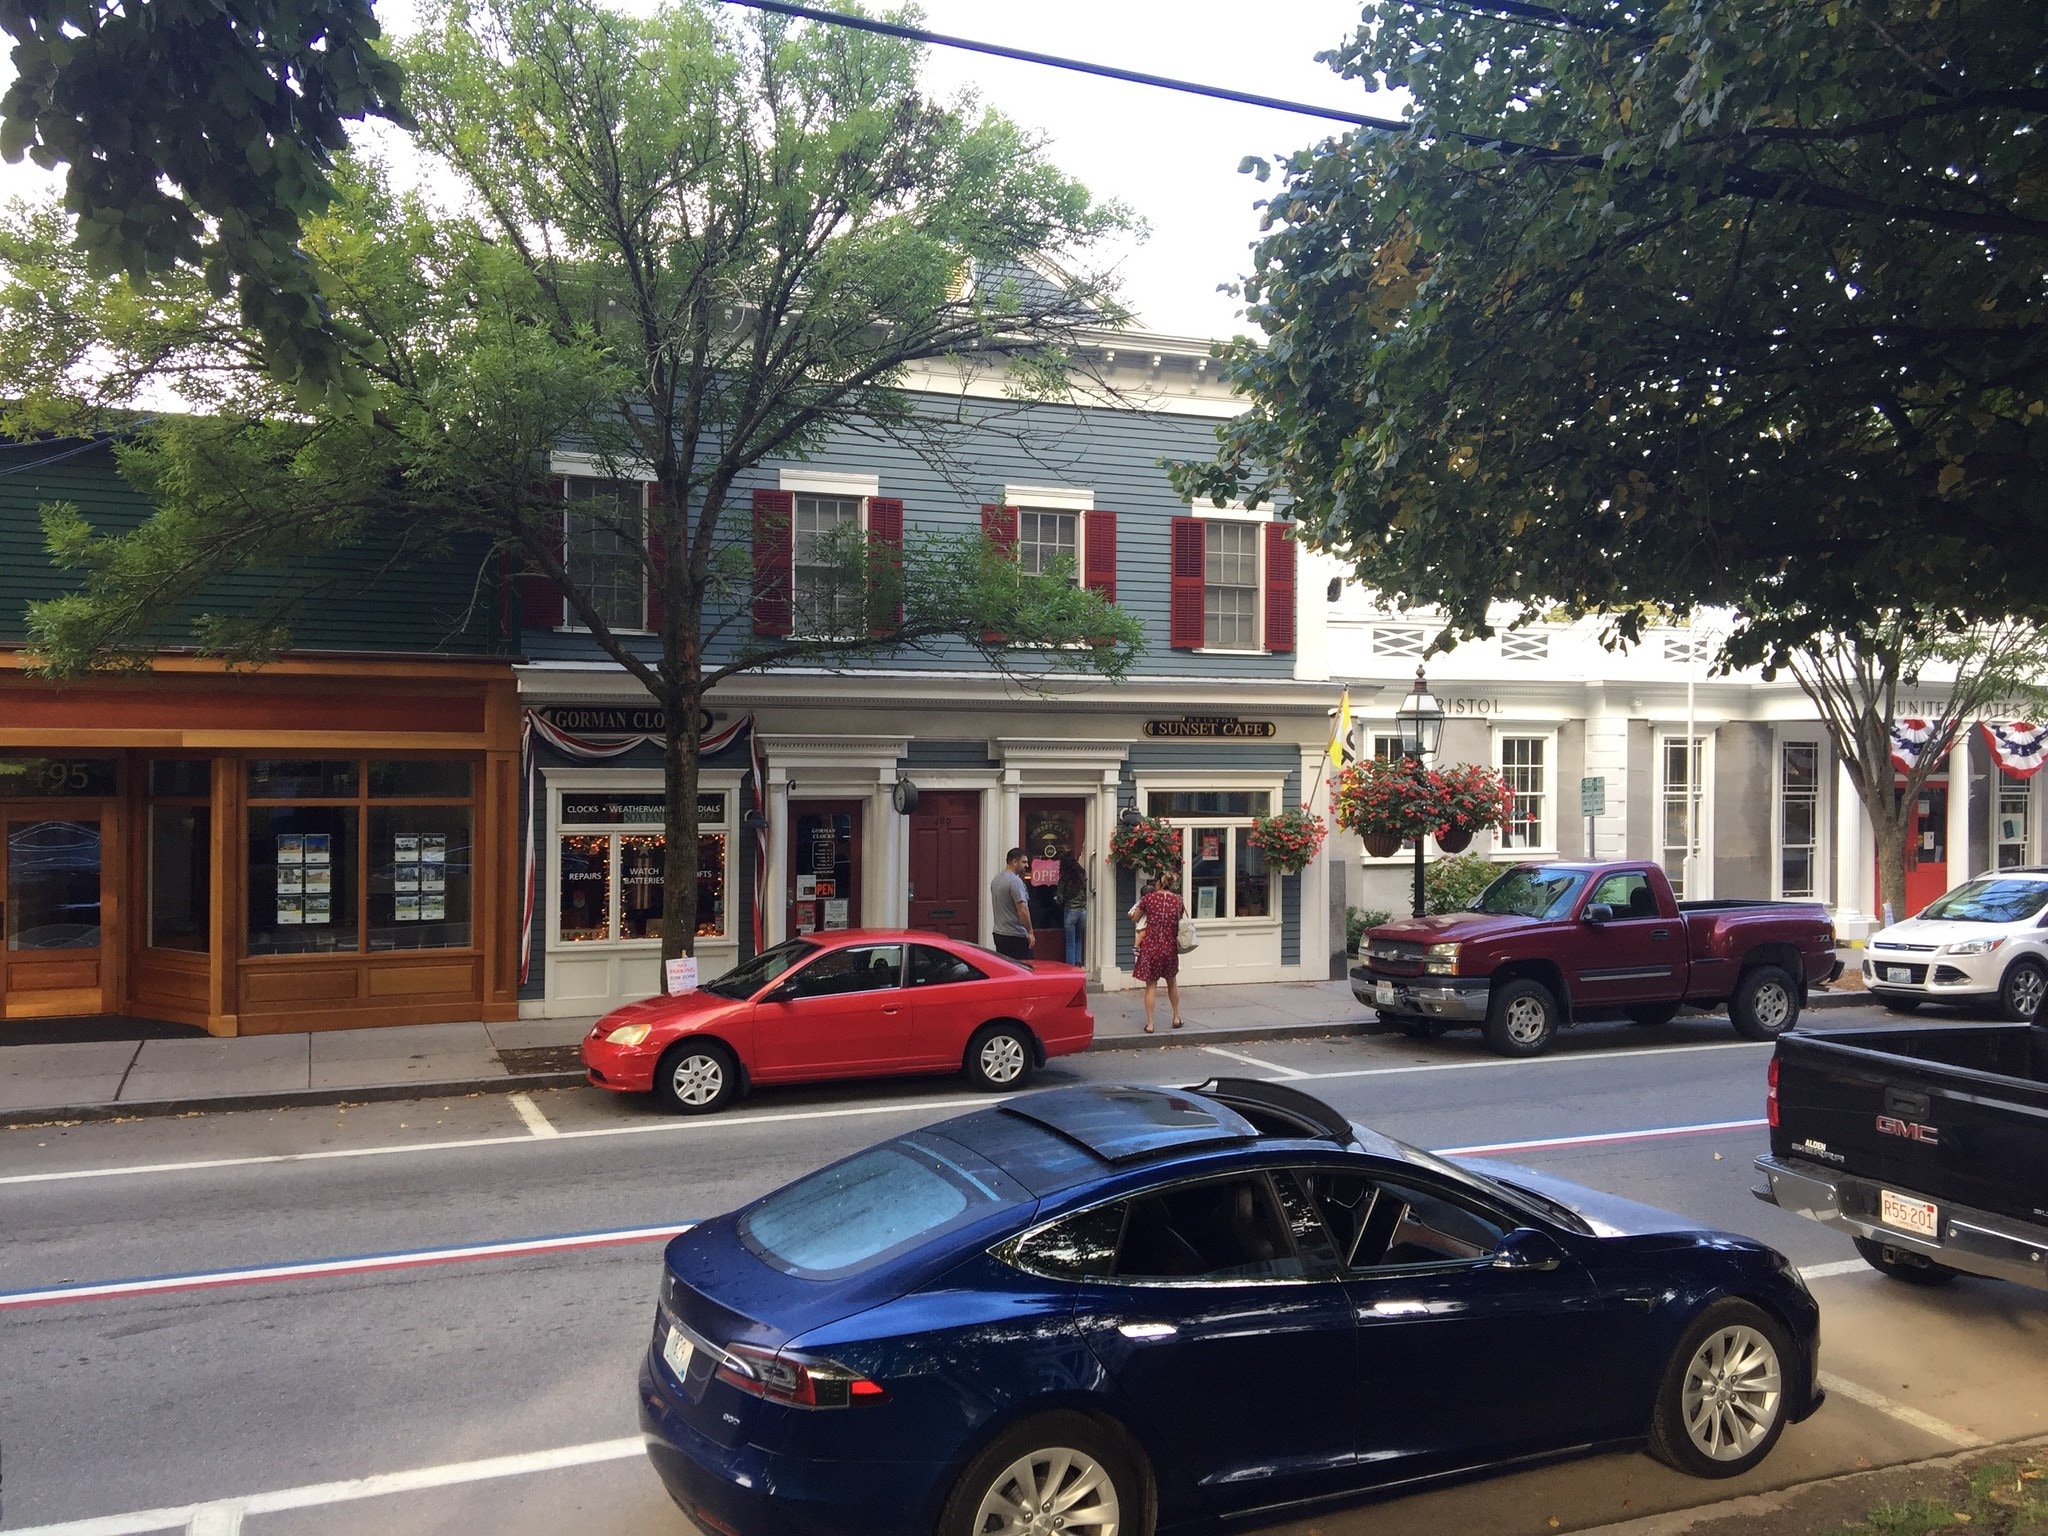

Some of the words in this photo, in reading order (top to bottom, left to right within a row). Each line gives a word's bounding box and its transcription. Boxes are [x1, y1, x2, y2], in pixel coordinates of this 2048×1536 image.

[1436, 698, 1503, 714] RISTOL
[1896, 700, 1945, 716] UNITE
[555, 711, 627, 729] GORMAN
[633, 712, 665, 729] CLO
[1159, 722, 1218, 736] SUNSET
[567, 805, 599, 814] CLOCKS
[609, 805, 665, 814] WEATHERVAN
[697, 805, 721, 813] DIALS
[644, 812, 664, 823] FAN
[568, 872, 602, 881] REPAIRS
[630, 867, 660, 876] WATCH
[696, 870, 712, 878] IFTS
[1032, 869, 1058, 882] OPE
[624, 876, 665, 885] BATTERIES
[816, 883, 834, 898] PEN
[669, 967, 696, 975] PARKING
[1876, 1115, 1938, 1145] GMC
[1805, 1138, 1827, 1151] ALDEN
